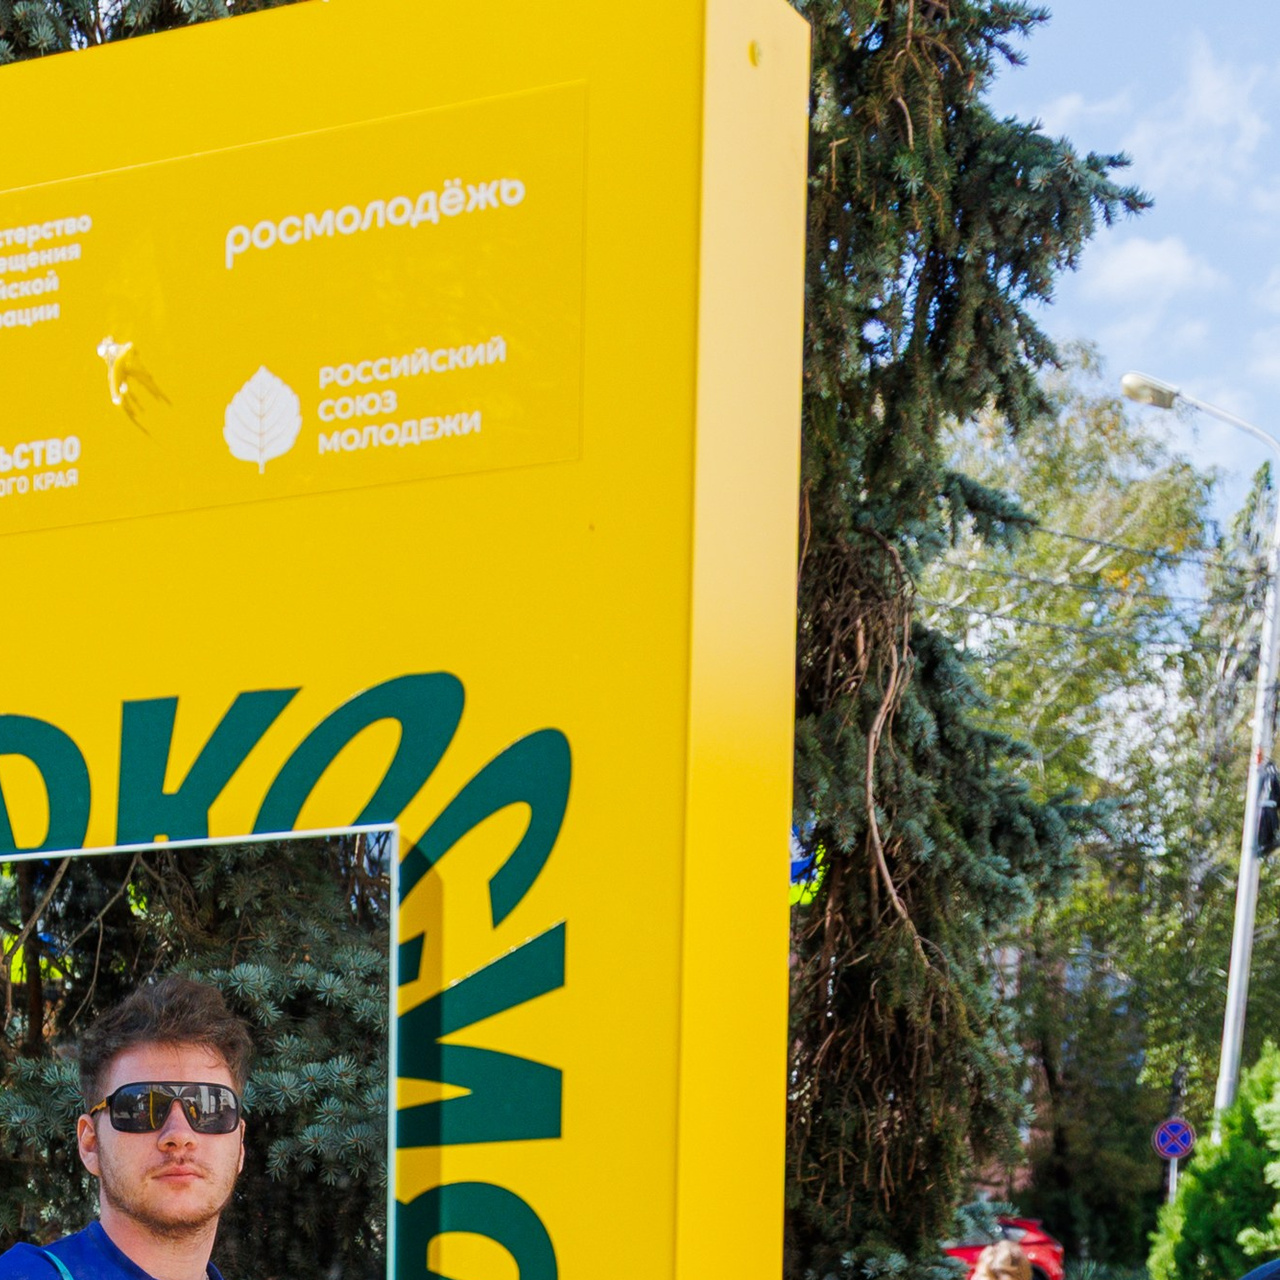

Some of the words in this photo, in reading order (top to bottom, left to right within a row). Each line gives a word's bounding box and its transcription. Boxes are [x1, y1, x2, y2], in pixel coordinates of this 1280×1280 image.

[318, 335, 507, 390] РОССИЙСКИЙ
[317, 389, 398, 422] СОЮЗ
[318, 410, 482, 455] МОЛОДЕЖИ
[32, 468, 79, 492] КРАЯ
